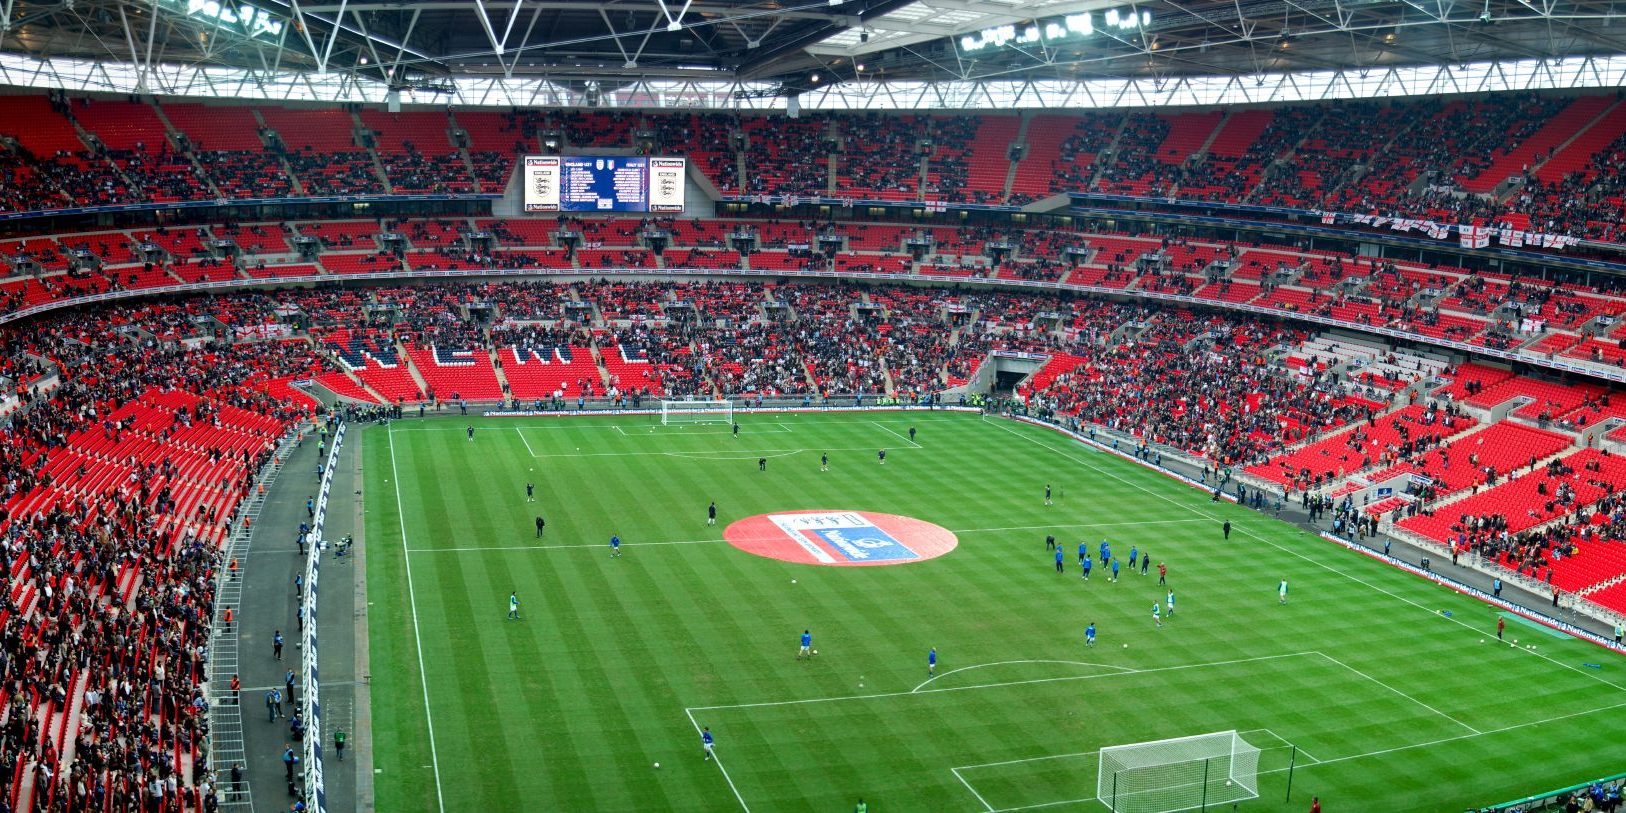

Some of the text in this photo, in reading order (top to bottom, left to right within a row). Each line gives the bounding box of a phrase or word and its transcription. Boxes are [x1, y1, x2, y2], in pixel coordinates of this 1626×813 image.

[1326, 532, 1608, 646] Nationwide Nationwide Nationwide Nationwide Nationwide Nationwide Nationwide
